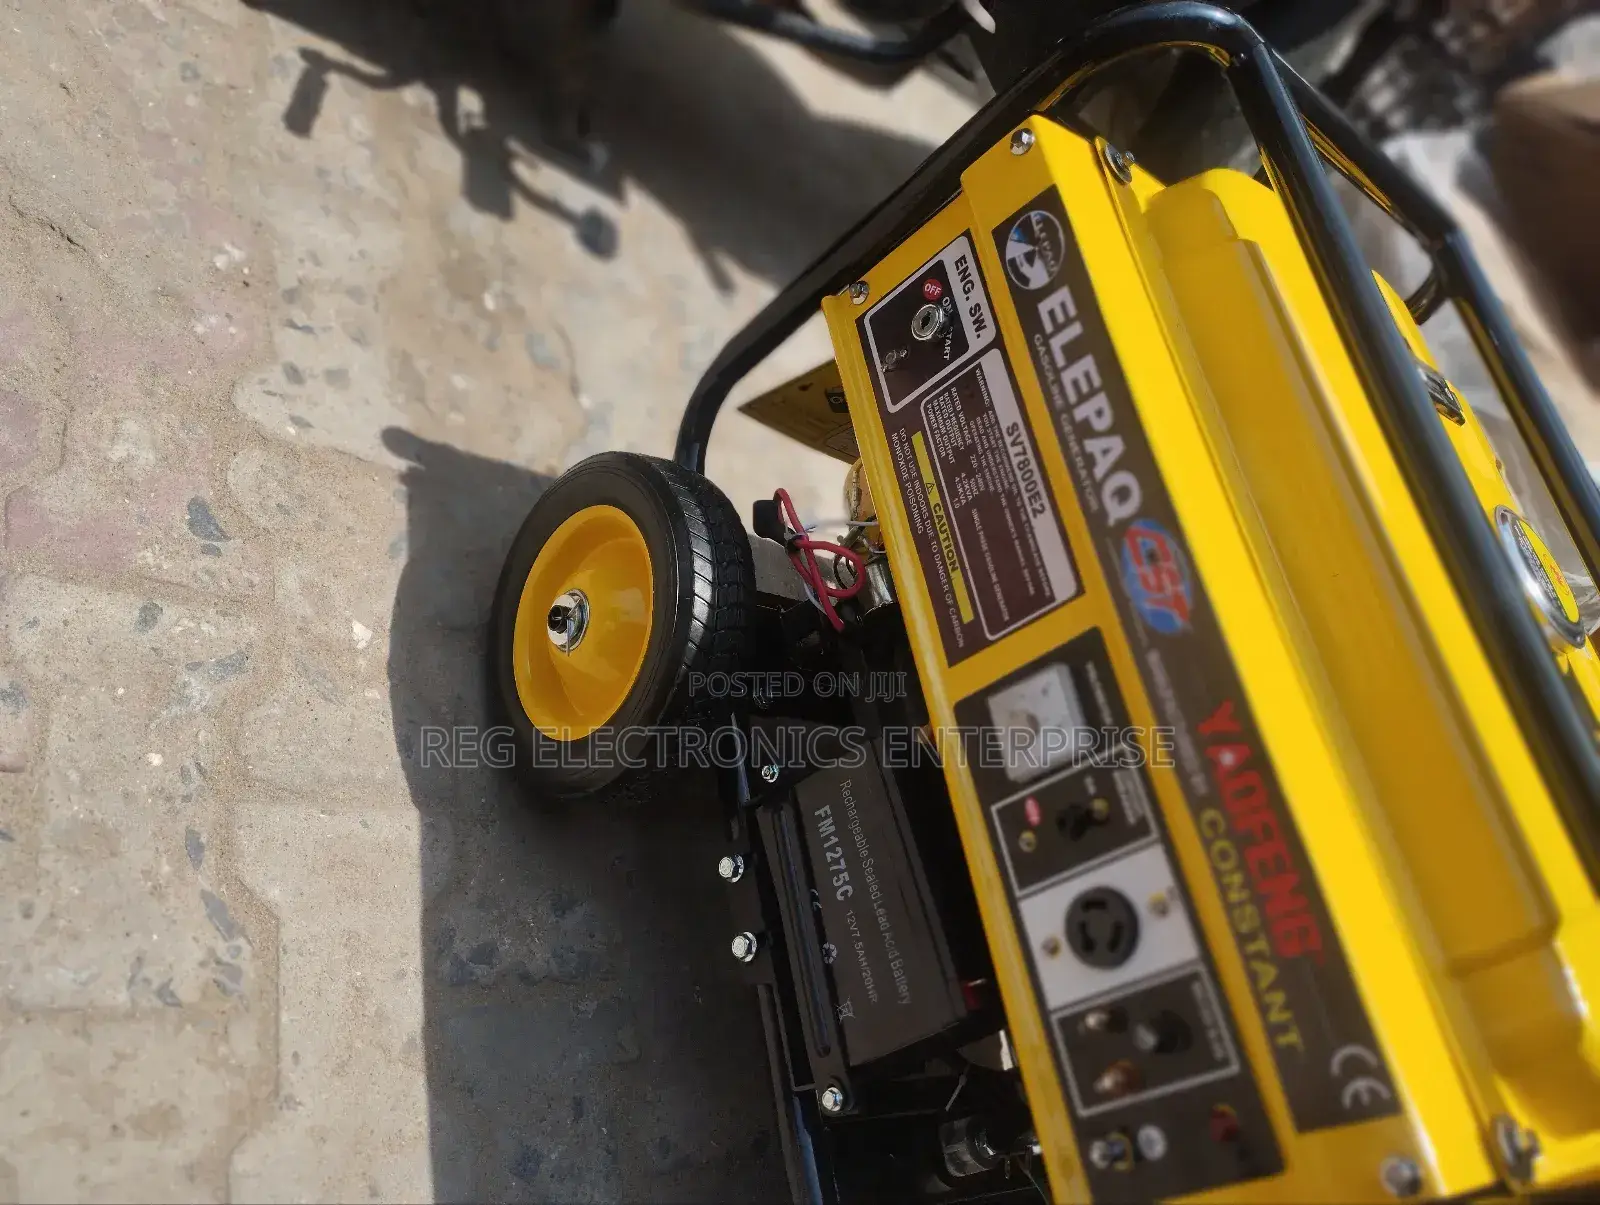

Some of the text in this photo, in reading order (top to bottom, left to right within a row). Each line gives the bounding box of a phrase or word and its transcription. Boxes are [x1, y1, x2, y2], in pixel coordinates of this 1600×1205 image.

[924, 283, 941, 296] OFF
[942, 296, 954, 315] ON
[954, 254, 987, 339] ENG. SW.
[943, 391, 954, 413] RATED
[949, 412, 965, 451] FREQUENCY
[975, 368, 990, 408] WARNING:
[982, 412, 991, 428] YOU
[1037, 285, 1142, 527] ELEPAQ
[891, 432, 924, 534] MONOXIDE POISONING
[926, 403, 960, 509] POWER FACTOR 1.0
[932, 399, 967, 506] MAXIMUM OUTPUT 4.5KVA
[938, 395, 973, 501] RATED OUTPUT 4.2KVA
[950, 386, 962, 411] RATED
[958, 411, 973, 446] VOLTAGE
[969, 454, 979, 468] 220
[975, 472, 986, 491] 240V
[1006, 422, 1046, 519] SV7800E2
[899, 427, 964, 648] DO NOT USE INDOORS DUE TO DANGER OF CARBON
[932, 502, 959, 574] CAUTION
[814, 804, 853, 901] FM1275C
[839, 779, 911, 1004] Rechargeable Sealed Lead Acid Battery
[1195, 808, 1300, 1045] CONSTANT
